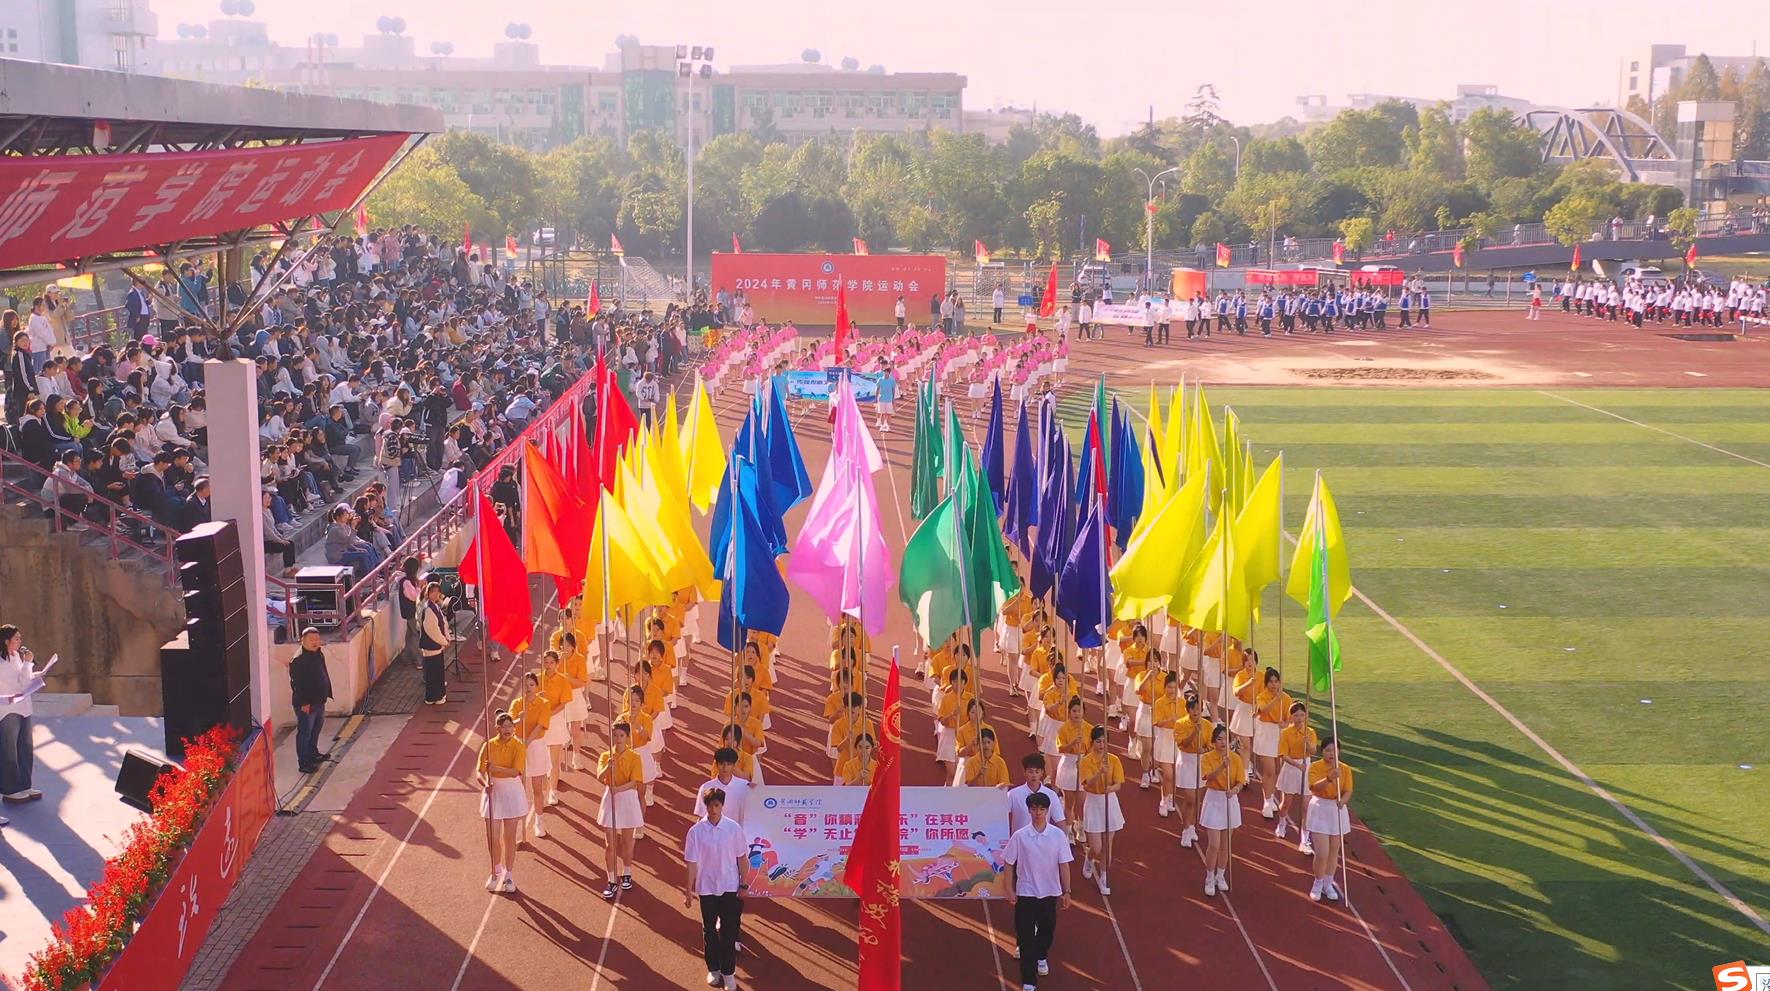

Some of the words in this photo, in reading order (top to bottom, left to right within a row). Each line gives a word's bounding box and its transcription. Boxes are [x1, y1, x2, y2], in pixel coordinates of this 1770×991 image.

[736, 278, 919, 292] 2024年黄冈师范学院运动会
